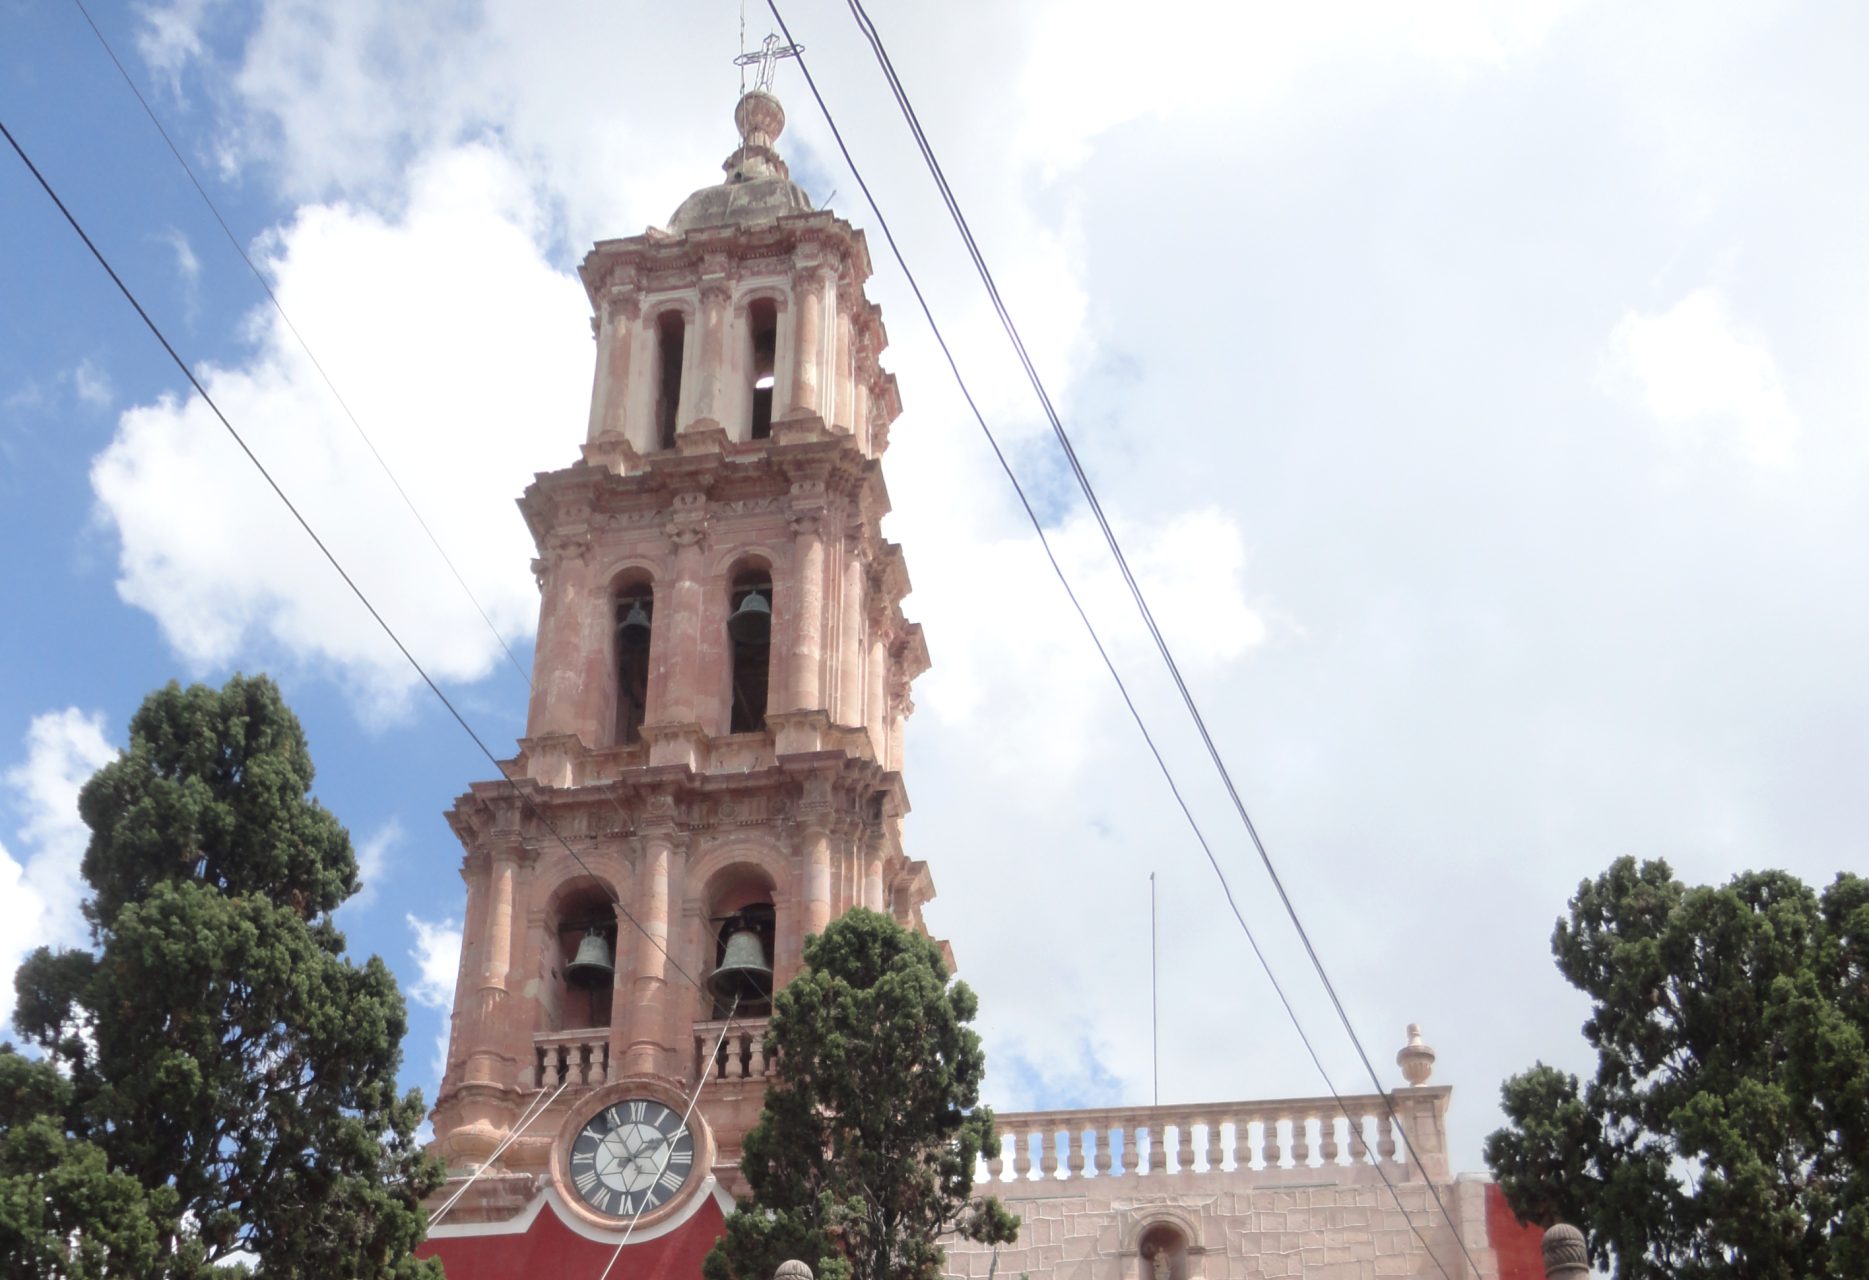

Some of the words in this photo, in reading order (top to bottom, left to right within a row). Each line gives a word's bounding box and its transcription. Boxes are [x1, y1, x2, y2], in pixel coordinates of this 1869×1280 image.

[629, 1102, 647, 1122] XII
[582, 1125, 604, 1143] X
[667, 1125, 689, 1143] II
[573, 1151, 595, 1164] IX
[670, 1150, 693, 1164] III
[591, 1186, 611, 1212] VII
[618, 1194, 634, 1215] VI
[646, 1189, 662, 1209] V
